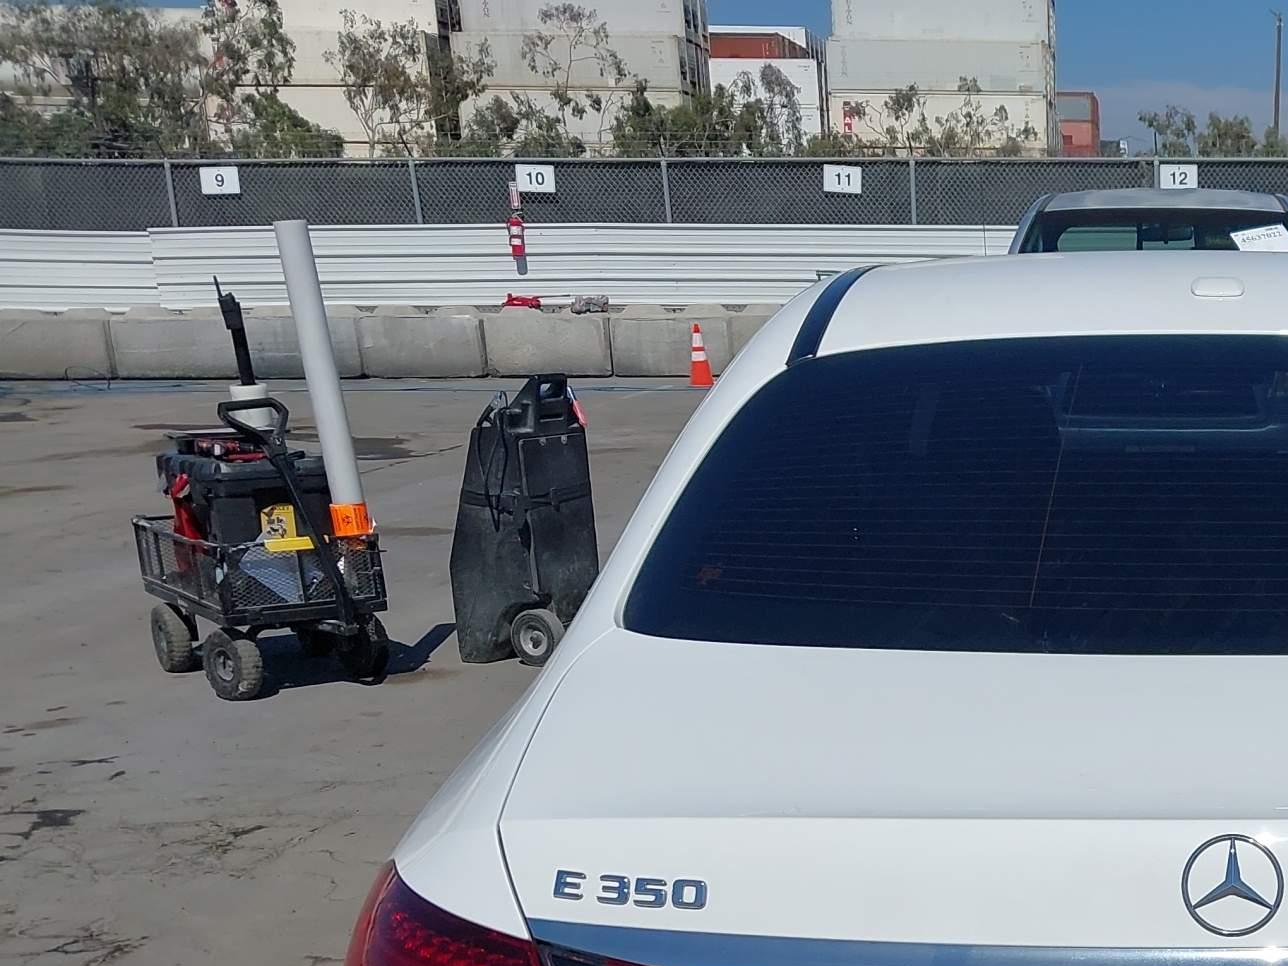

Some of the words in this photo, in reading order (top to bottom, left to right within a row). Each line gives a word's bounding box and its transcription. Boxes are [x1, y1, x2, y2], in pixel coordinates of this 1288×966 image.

[214, 173, 225, 188] 9
[526, 171, 545, 186] 10
[834, 172, 851, 187] 11
[1170, 171, 1188, 185] 12
[553, 869, 587, 901] E
[596, 874, 708, 910] 350
